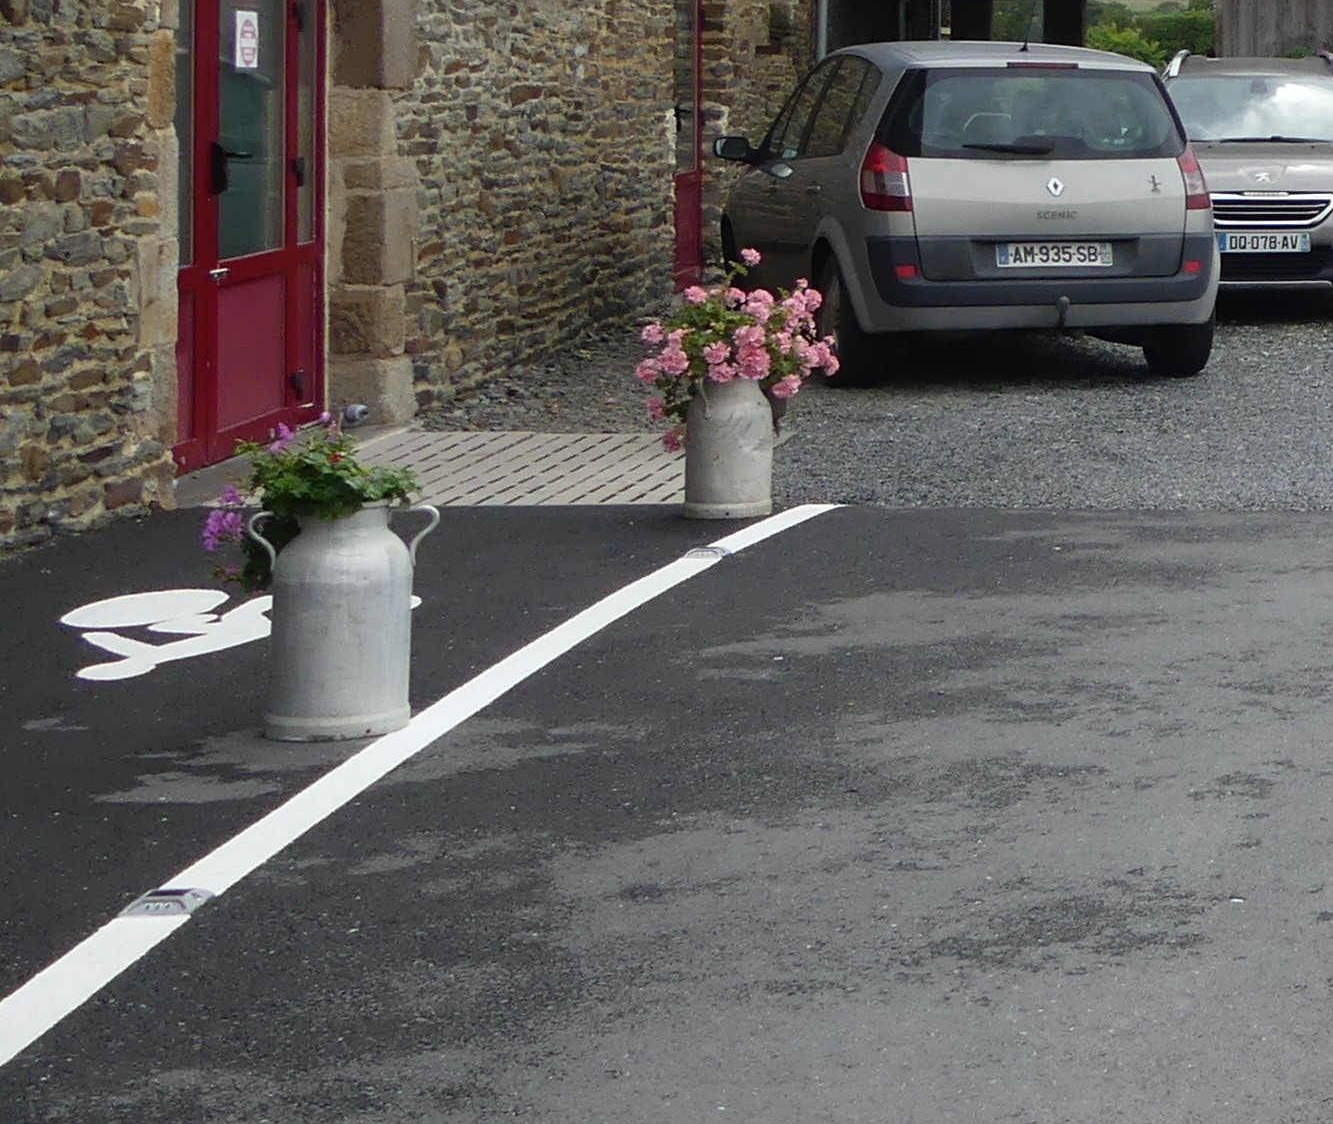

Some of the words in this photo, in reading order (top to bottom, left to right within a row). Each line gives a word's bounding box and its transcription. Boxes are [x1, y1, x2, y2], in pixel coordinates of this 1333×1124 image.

[1036, 210, 1078, 220] SCENIC
[1229, 235, 1299, 250] DQ-078-AV
[1012, 245, 1098, 264] AM-935-SB
